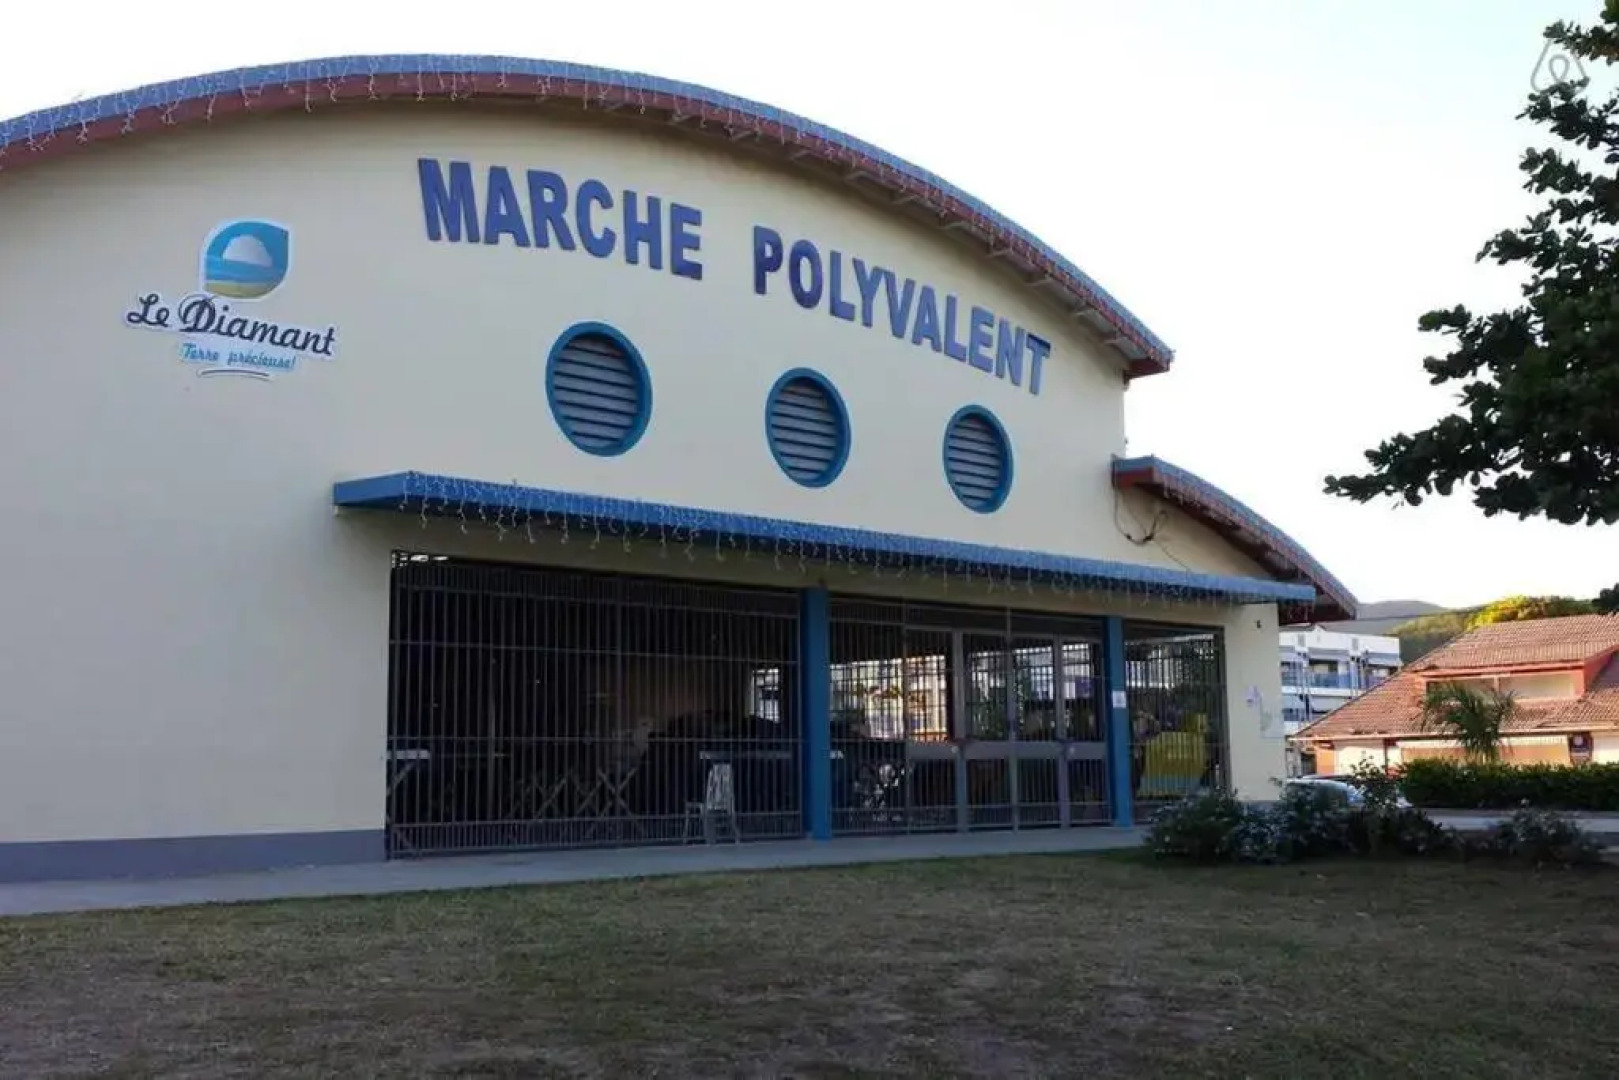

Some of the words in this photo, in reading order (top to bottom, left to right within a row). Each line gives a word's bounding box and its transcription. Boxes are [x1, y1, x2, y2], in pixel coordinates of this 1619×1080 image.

[418, 158, 703, 280] MARCHE
[753, 225, 1051, 395] POLYVALENT
[127, 293, 170, 328] Le
[179, 294, 335, 355] Diamant
[182, 342, 219, 361] Terre
